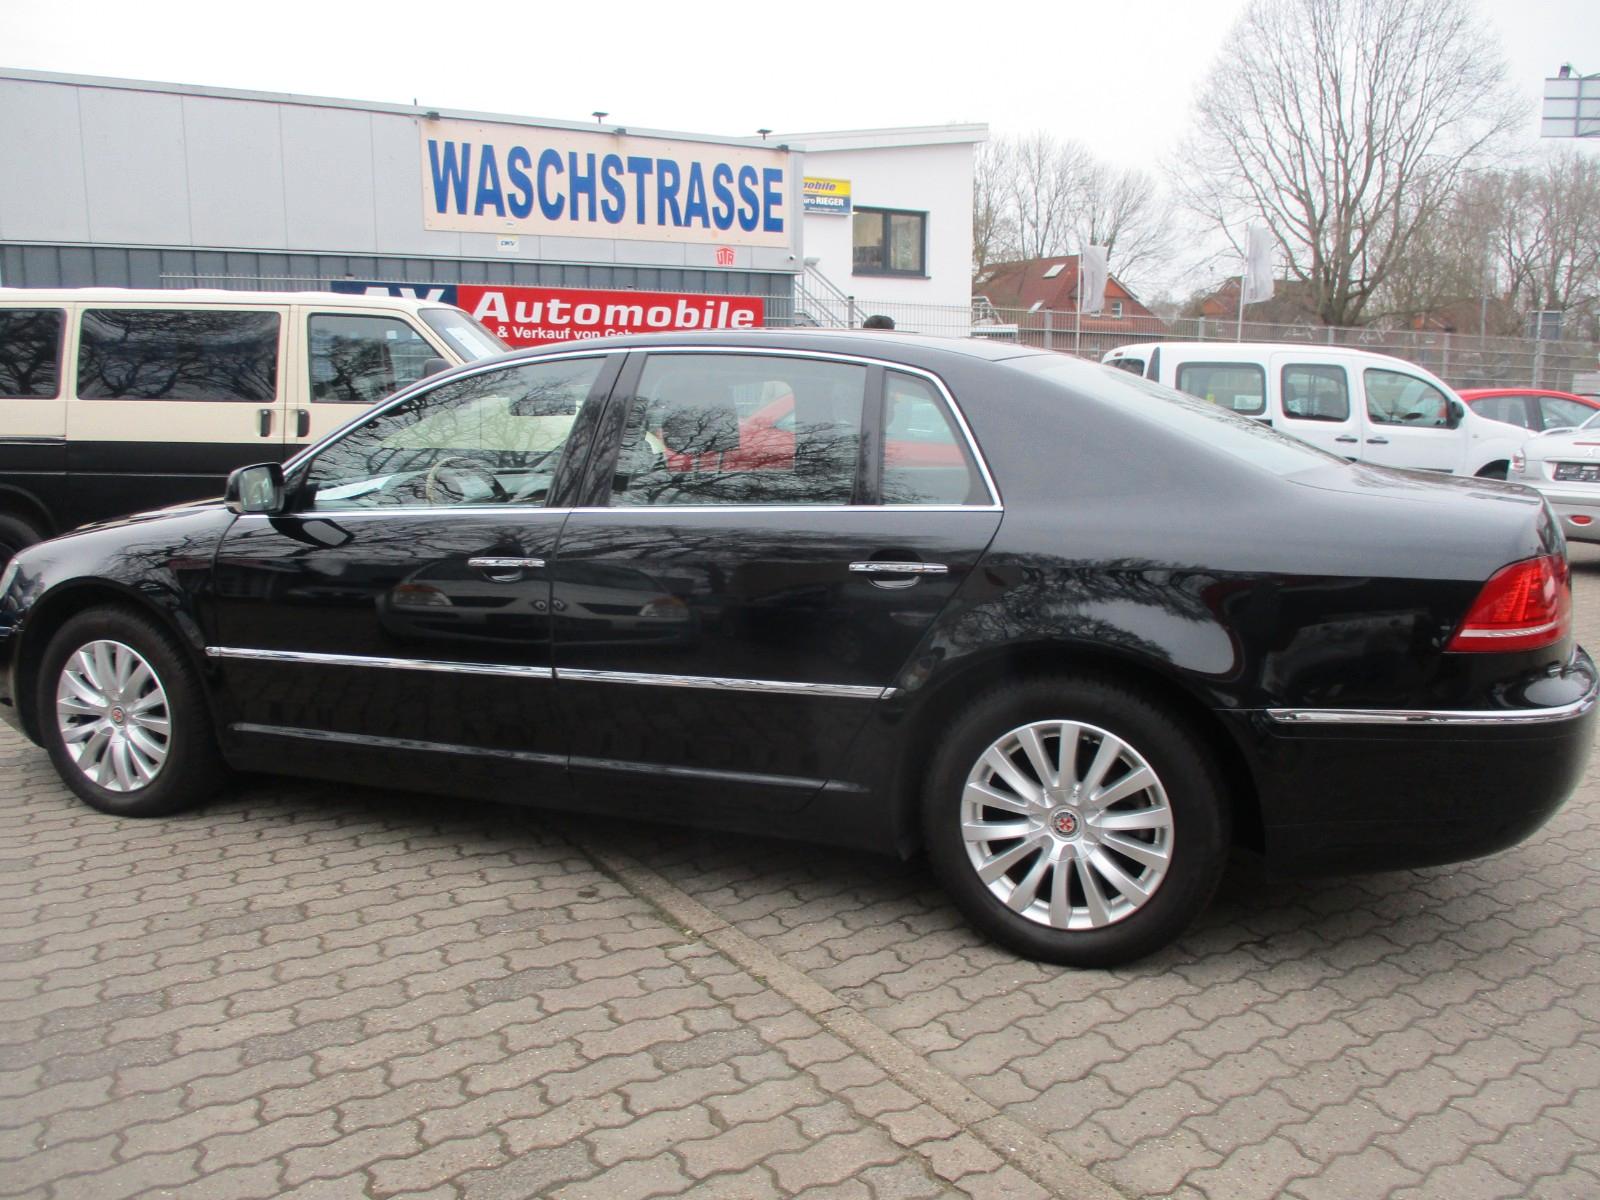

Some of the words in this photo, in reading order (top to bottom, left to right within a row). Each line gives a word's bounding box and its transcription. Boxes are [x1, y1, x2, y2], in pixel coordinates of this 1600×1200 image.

[428, 139, 784, 232] WASCHSTRASSE
[815, 197, 844, 206] RIEGER
[472, 291, 754, 328] Automobile
[496, 325, 509, 338] &
[512, 326, 571, 339] Verkauf
[574, 330, 601, 340] von
